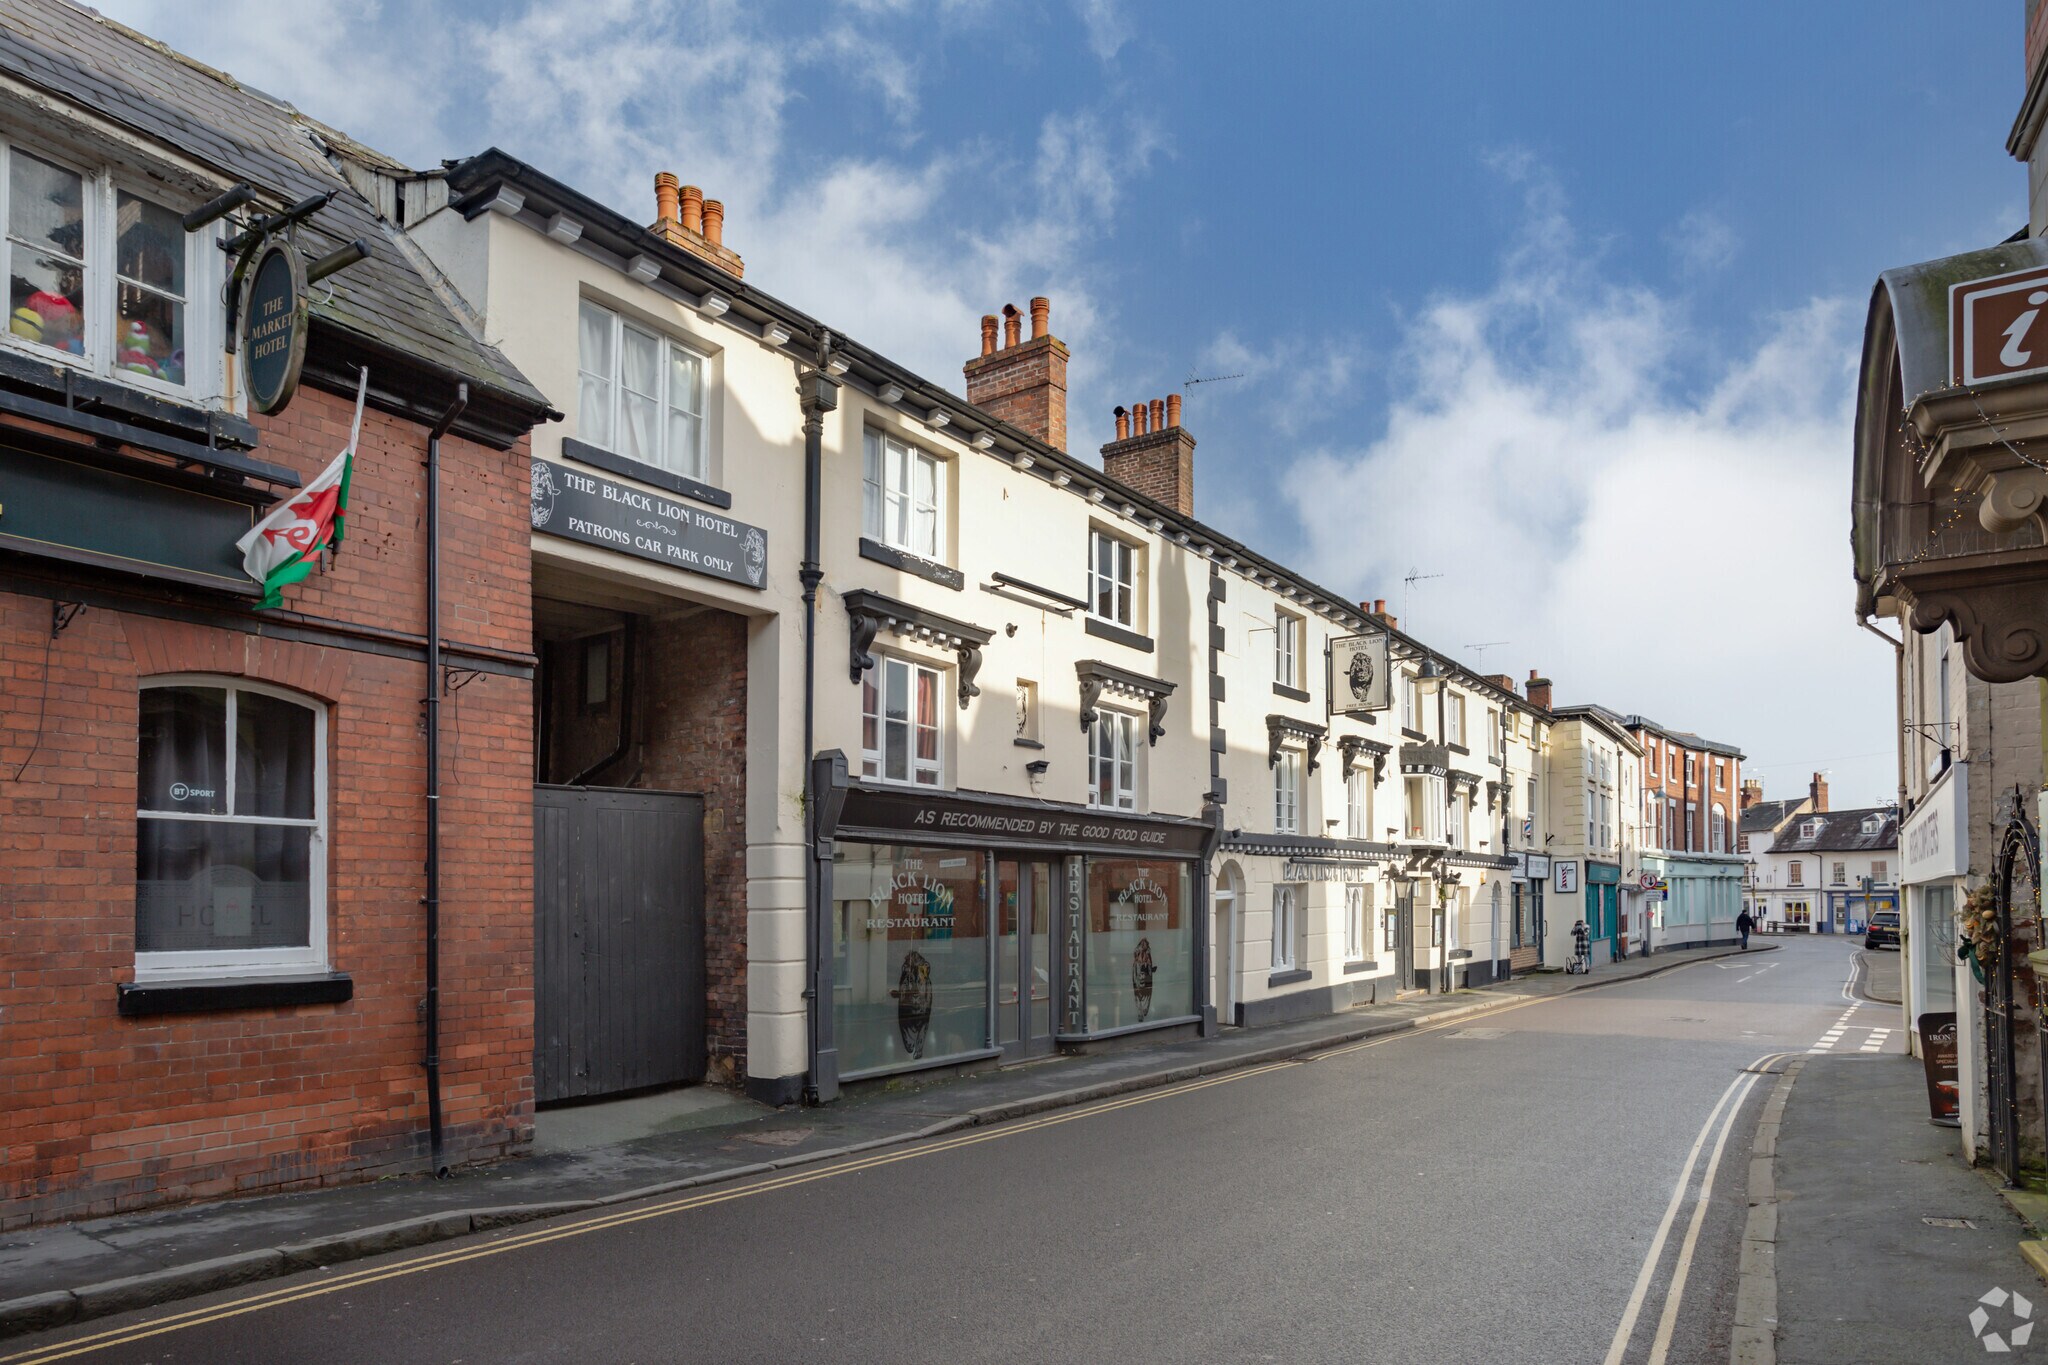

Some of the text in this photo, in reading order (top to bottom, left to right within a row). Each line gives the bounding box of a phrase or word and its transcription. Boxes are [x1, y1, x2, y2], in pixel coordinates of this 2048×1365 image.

[263, 296, 284, 316] THE
[251, 312, 293, 341] MARKET
[255, 335, 287, 360] HOTEL
[564, 472, 739, 538] THE BLACK LION HOTEL
[568, 516, 734, 573] PATRONS CAR PARK ONLY
[189, 789, 216, 798] SPORT
[914, 810, 1167, 844] AS RECOMMENDED BY THE GOOD FOOD GUIDE
[904, 858, 923, 870] THE
[1138, 867, 1150, 877] THE
[869, 871, 954, 913] BLACK LION
[898, 893, 931, 905] HOTEL
[1118, 878, 1168, 906] BLACK LION
[1134, 894, 1154, 904] HOTEL
[178, 904, 272, 927] HOL
[867, 917, 957, 929] RESTAURANT
[1116, 913, 1169, 922] RESTAURANT
[1068, 863, 1080, 1026] RESTAURANT
